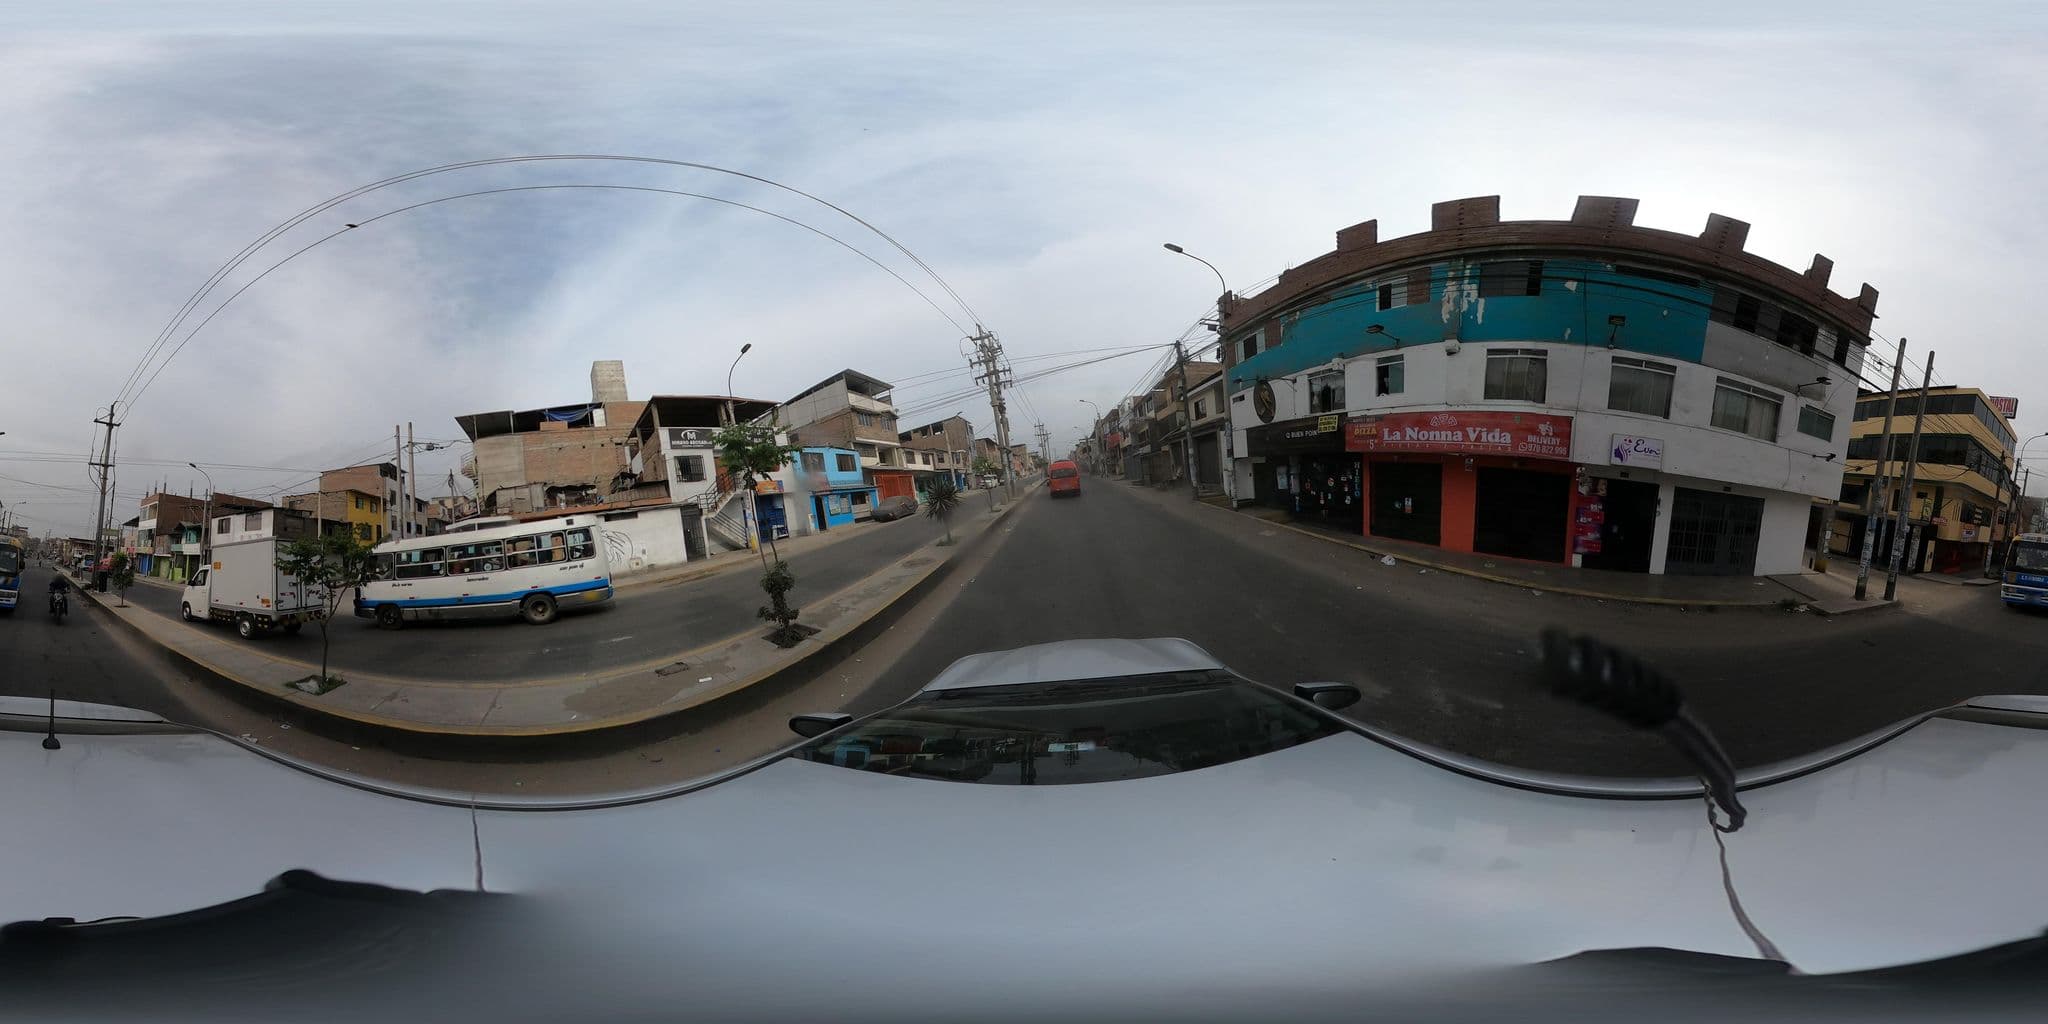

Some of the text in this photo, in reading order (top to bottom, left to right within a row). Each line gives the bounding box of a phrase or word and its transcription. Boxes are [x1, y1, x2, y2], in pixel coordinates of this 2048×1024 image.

[1383, 427, 1512, 444] La Nonna Vida
[1527, 435, 1561, 445] DELIVERY
